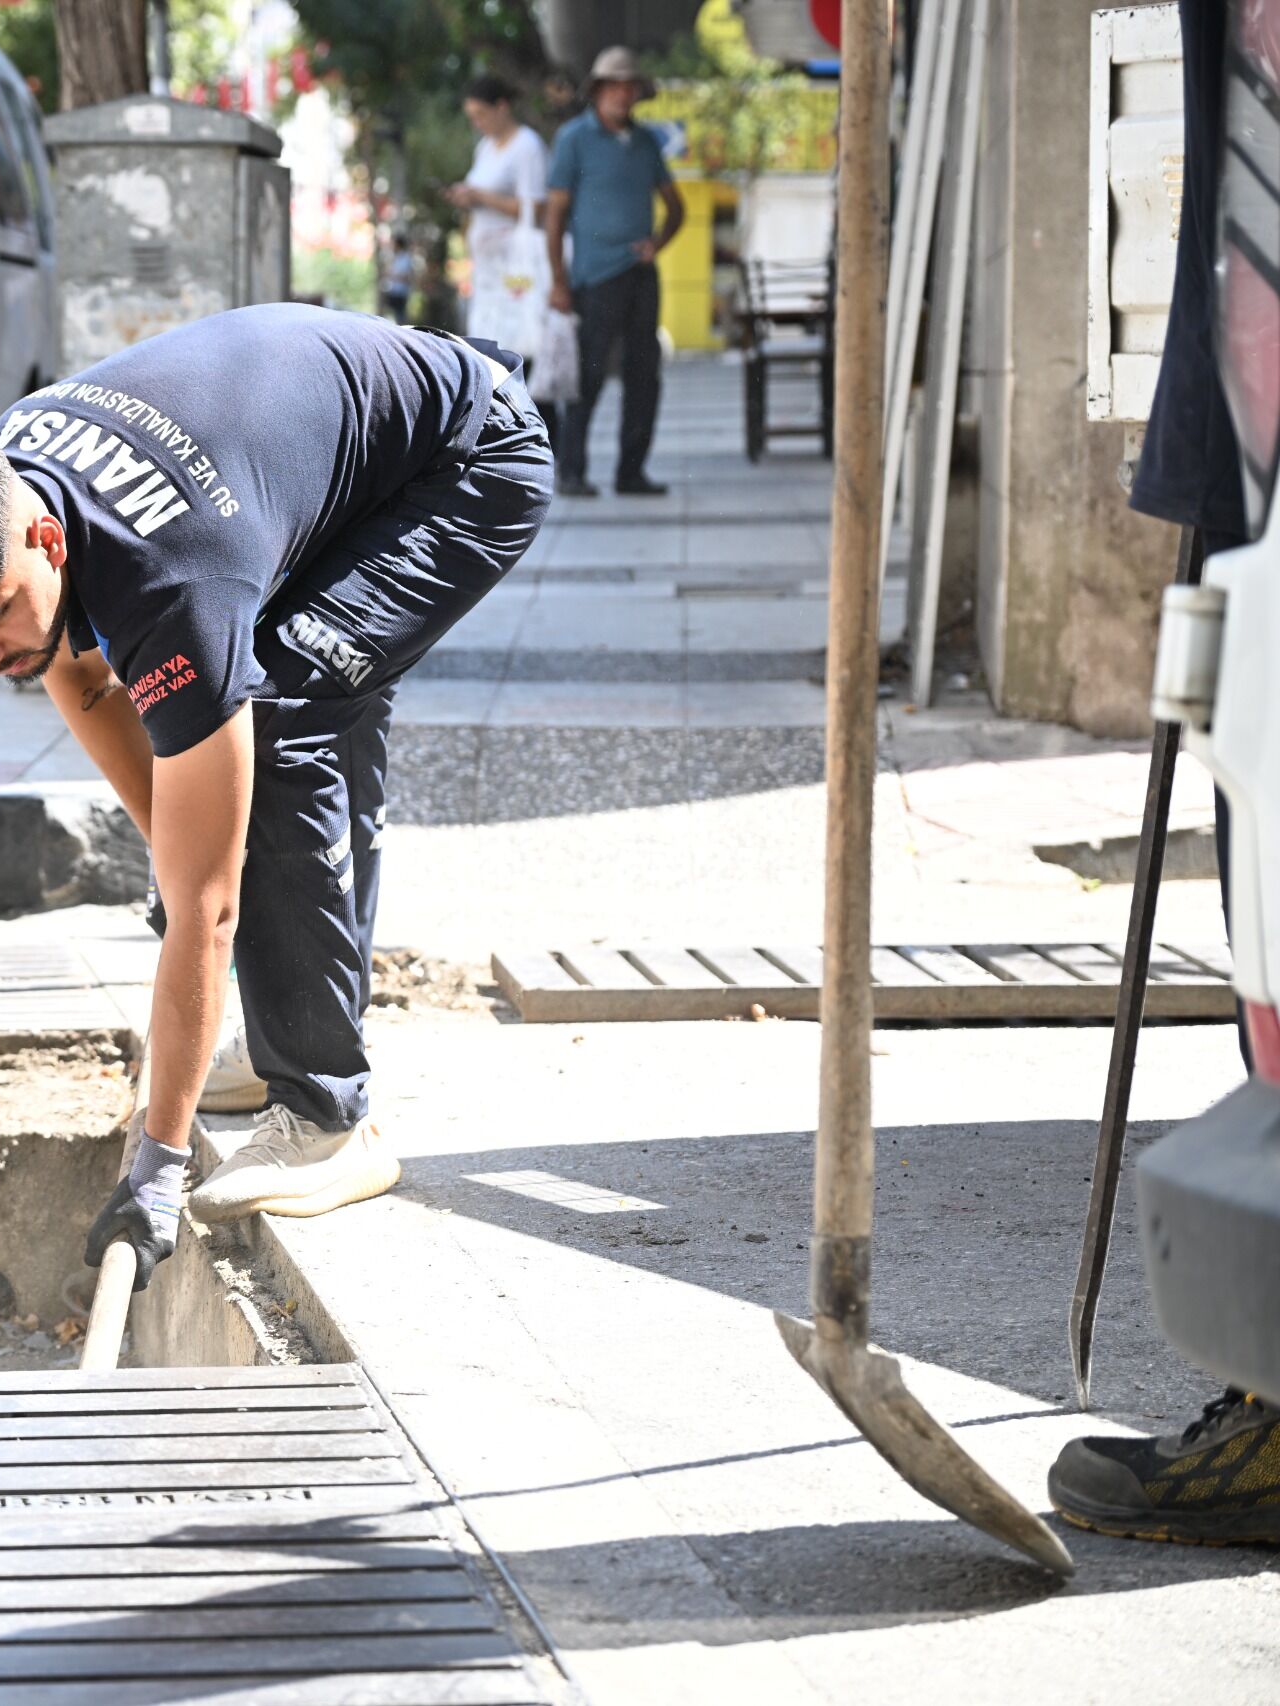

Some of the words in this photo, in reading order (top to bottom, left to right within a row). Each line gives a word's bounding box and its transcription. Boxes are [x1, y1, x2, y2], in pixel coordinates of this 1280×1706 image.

[188, 456, 218, 489] VE
[209, 486, 239, 517] SU
[167, 669, 198, 692] VAR
